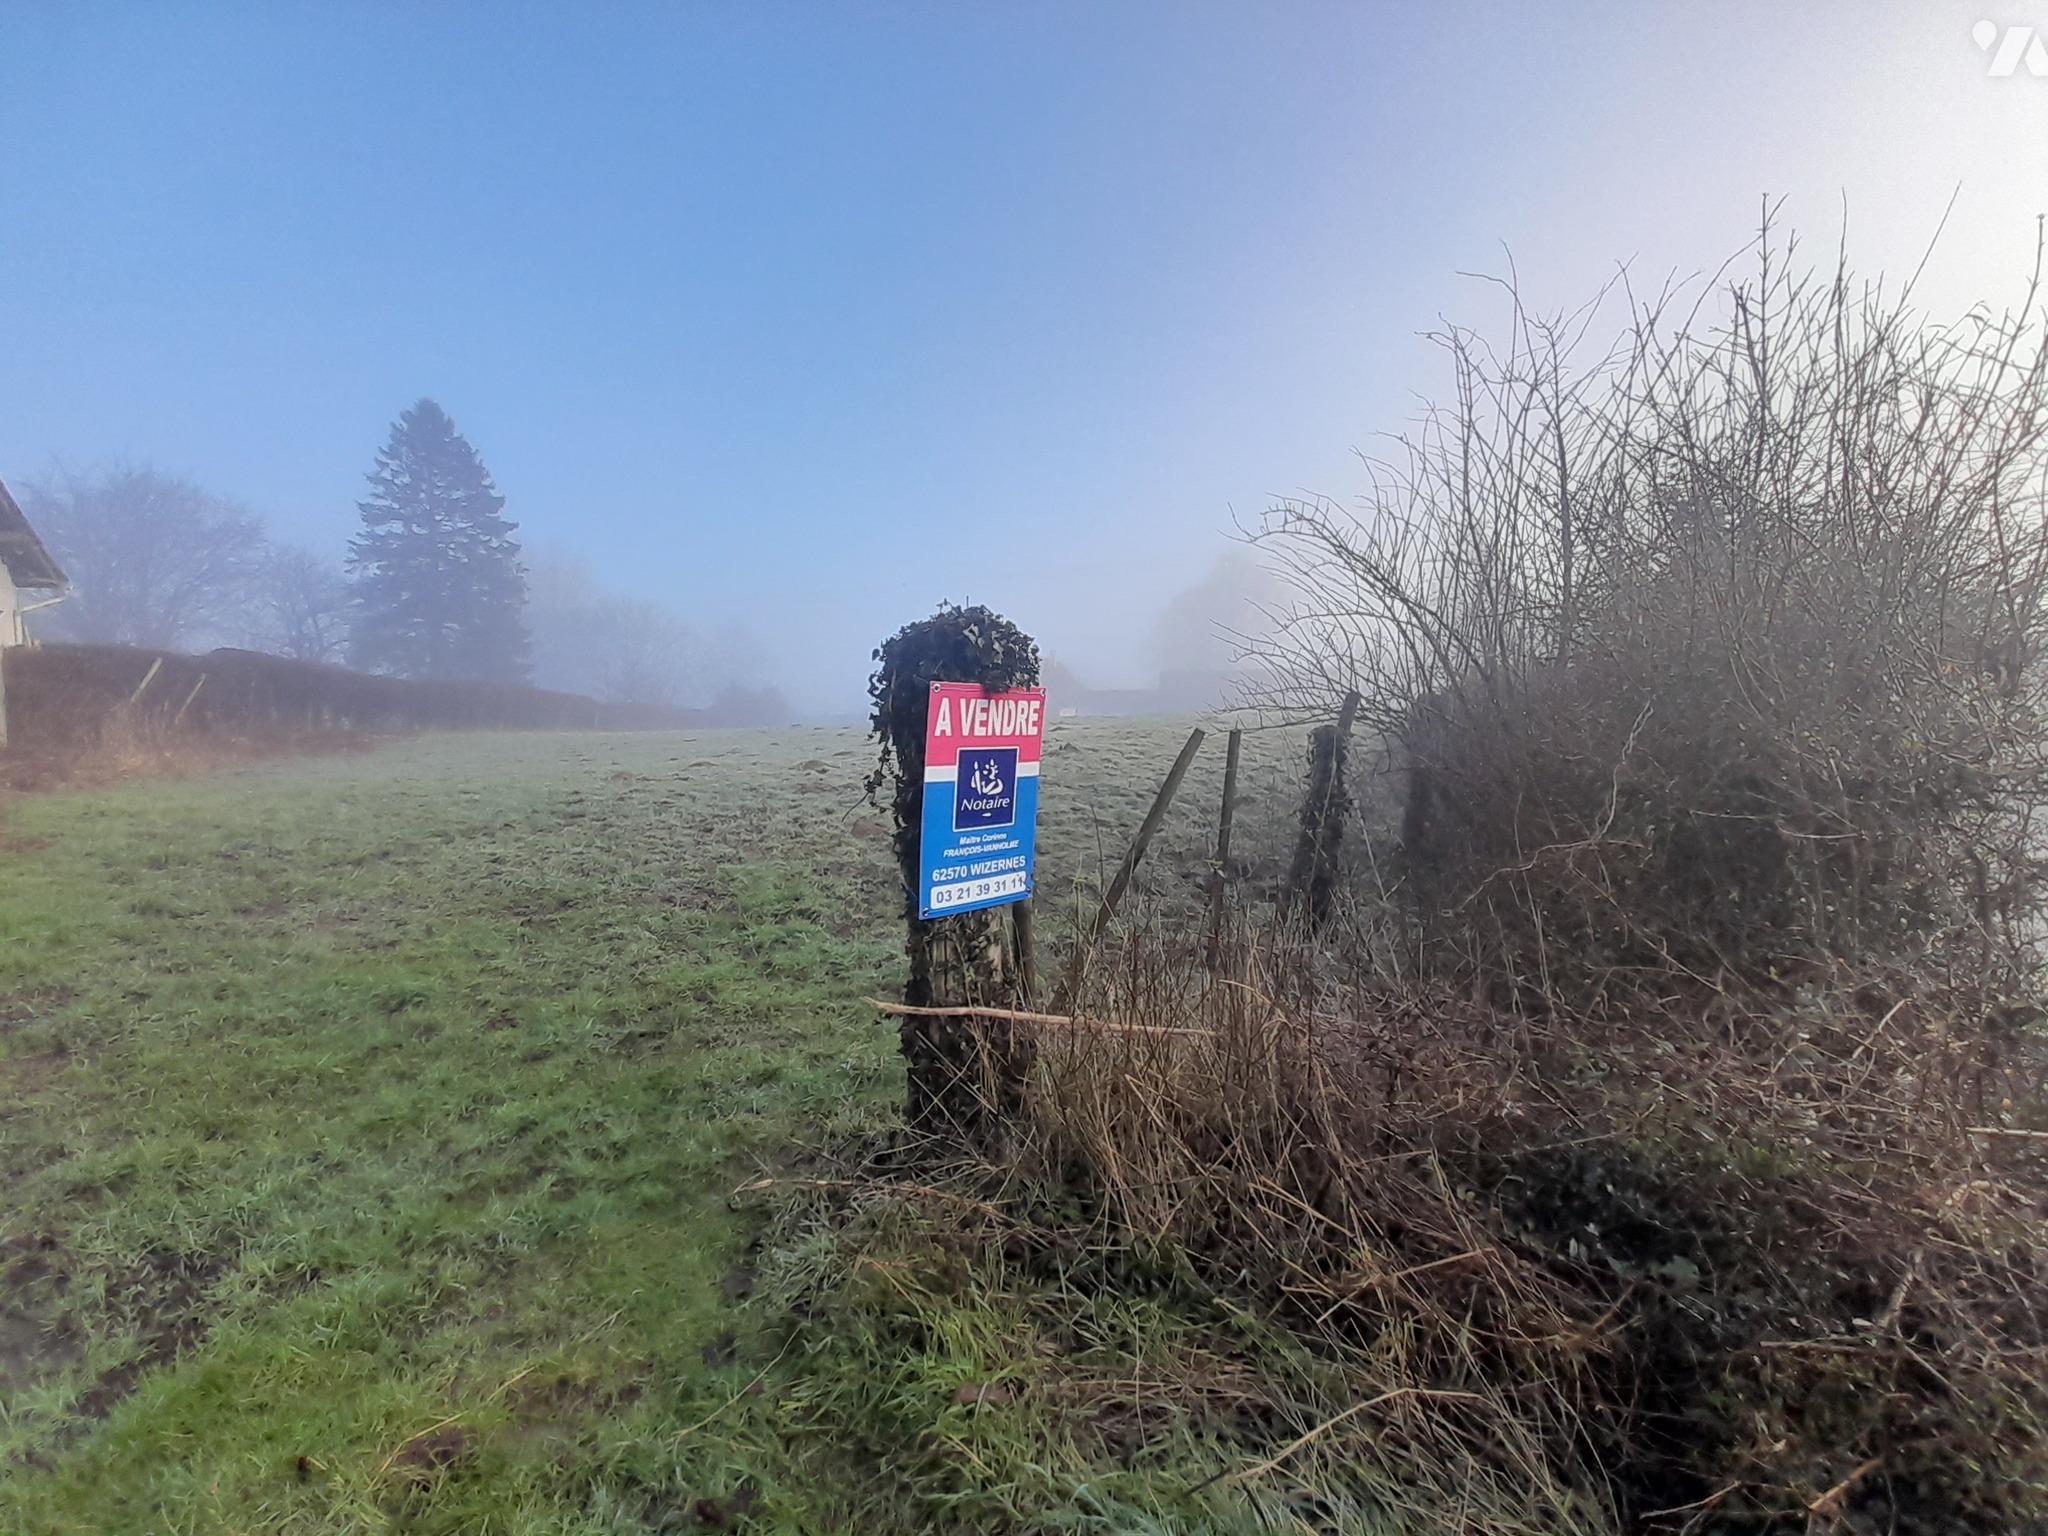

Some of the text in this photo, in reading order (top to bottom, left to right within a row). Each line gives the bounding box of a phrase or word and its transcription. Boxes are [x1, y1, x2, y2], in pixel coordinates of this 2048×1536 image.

[934, 697, 1041, 737] A VENDRE
[961, 796, 1010, 811] Notaire
[982, 832, 1007, 843] Corinne
[932, 855, 1026, 881] 62570 WIZERNES
[936, 875, 1024, 904] 03 21 39 31 11
